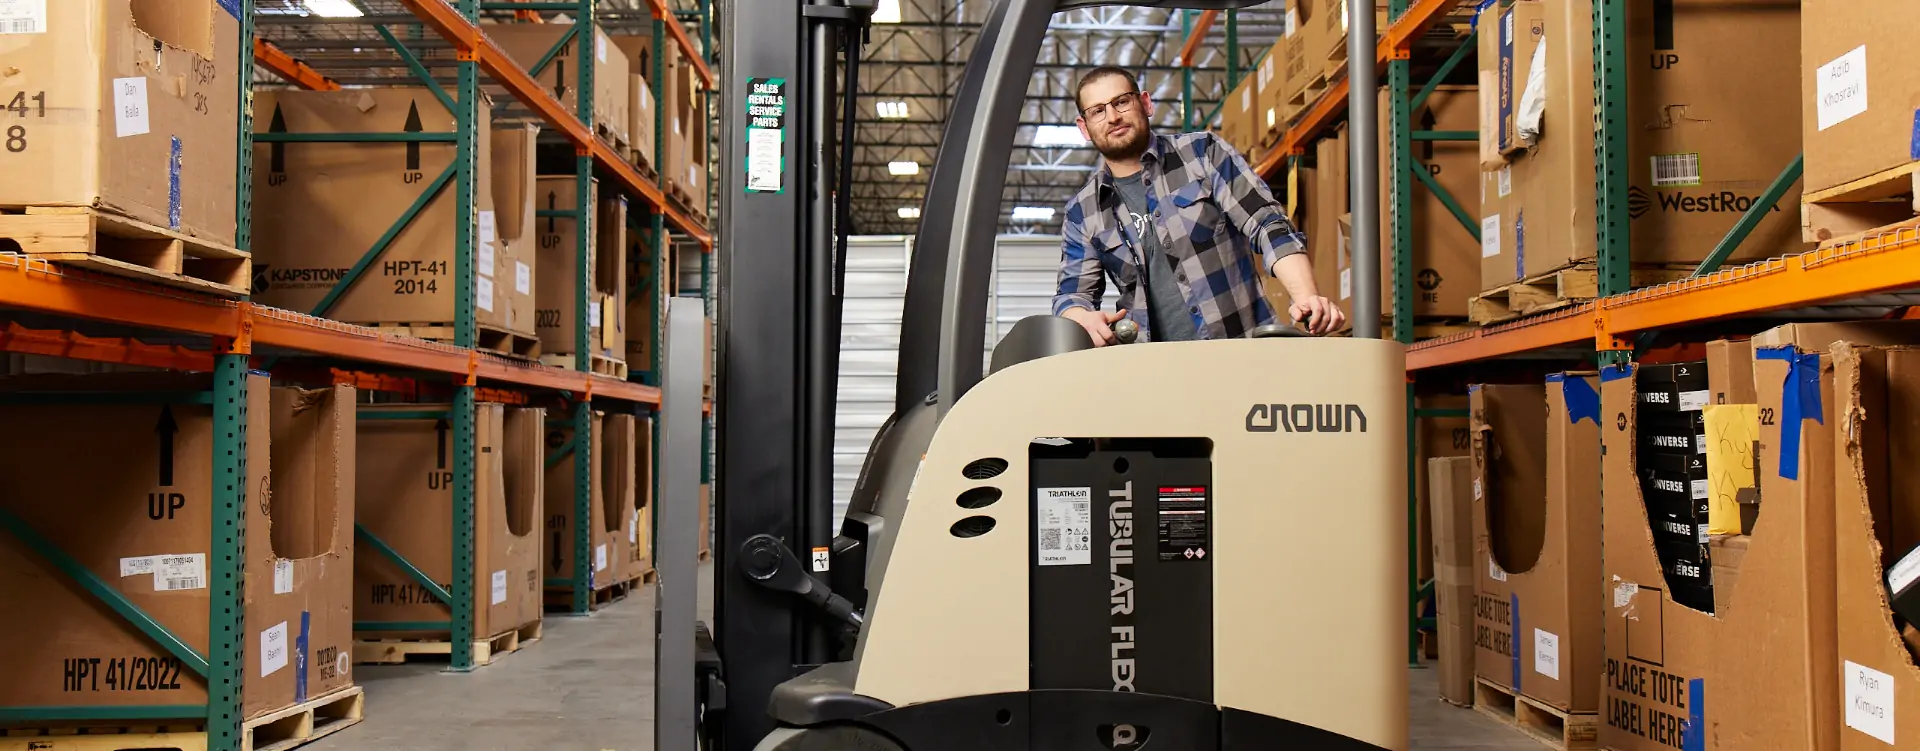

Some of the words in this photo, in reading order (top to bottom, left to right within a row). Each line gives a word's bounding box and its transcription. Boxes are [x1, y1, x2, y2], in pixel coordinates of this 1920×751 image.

[1650, 54, 1679, 70] UP
[125, 83, 137, 96] Dan
[753, 84, 779, 94] SALES
[748, 94, 784, 105] RENTALS
[749, 106, 783, 116] SERVICE
[752, 117, 779, 127] PARTS
[268, 174, 287, 187] UP
[403, 172, 423, 184] UP
[541, 235, 561, 249] UP
[384, 261, 447, 276] HPT-41
[394, 280, 438, 294] 2014
[1637, 391, 1669, 404] ONVERSE
[1245, 403, 1367, 432] CROWN
[428, 472, 453, 490] UP
[1048, 490, 1087, 498] TRIATHLON
[148, 493, 185, 520] UP
[1108, 480, 1135, 616] TUBULAR
[1494, 598, 1511, 626] TOTE
[1494, 628, 1512, 657] HERE
[105, 656, 181, 691] 41/2022
[1859, 670, 1880, 692] Ryan
[1607, 658, 1647, 698] PLACE
[1650, 669, 1685, 709] TOTE
[1855, 696, 1884, 719] Kimura
[1607, 695, 1646, 737] LABEL
[1649, 707, 1685, 750] HERE
